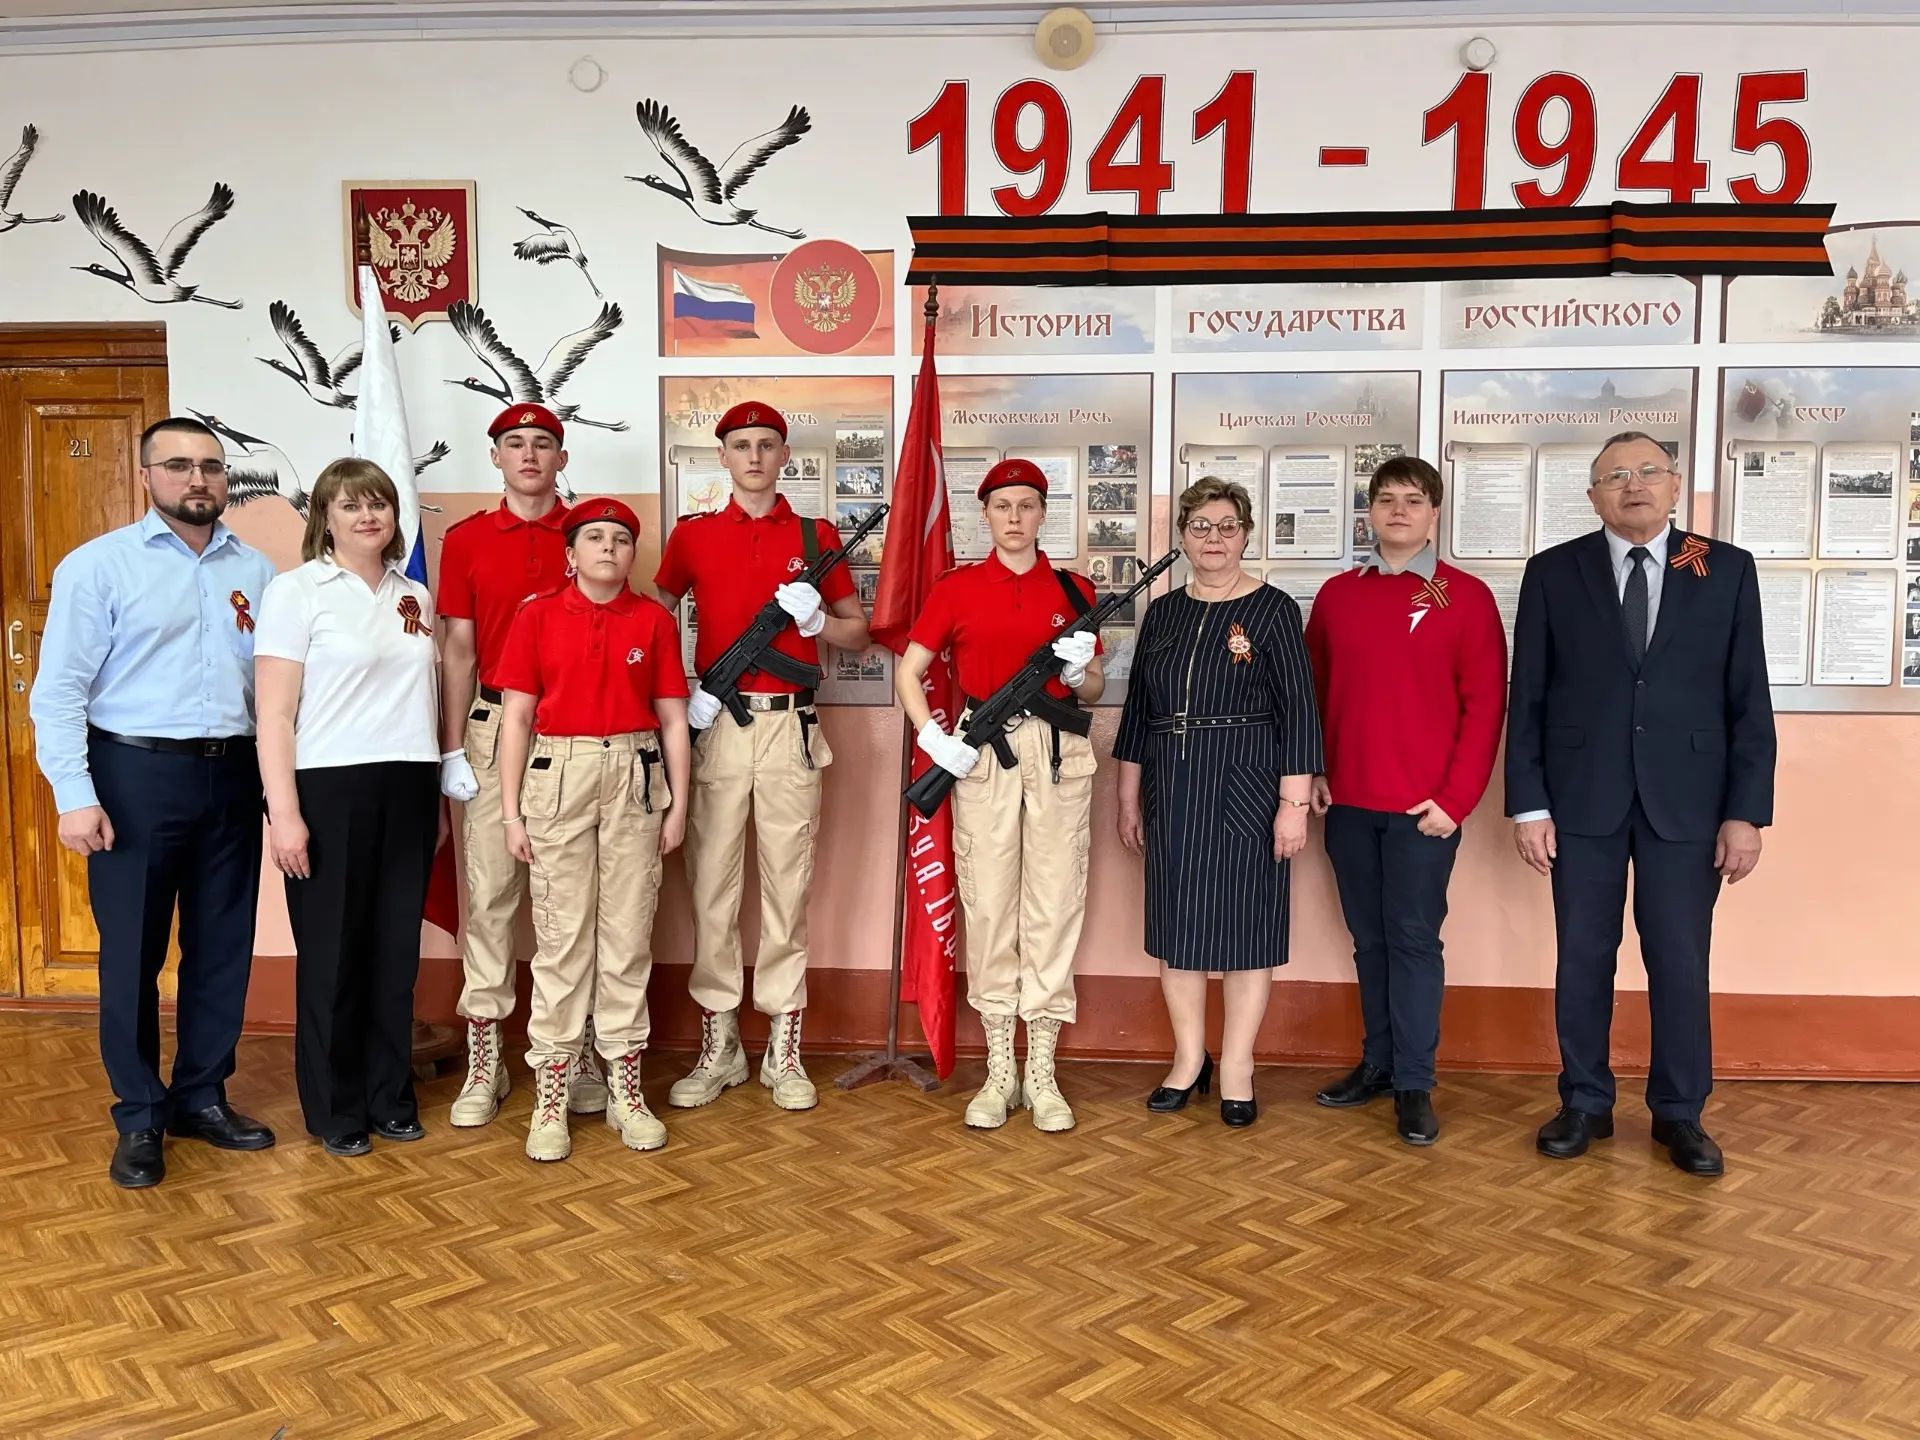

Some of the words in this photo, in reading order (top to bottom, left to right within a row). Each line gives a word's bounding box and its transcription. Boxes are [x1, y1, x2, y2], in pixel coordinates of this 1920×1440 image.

[907, 69, 1257, 217] 1941
[1421, 68, 1812, 212] 1945
[952, 409, 1060, 425] Московская
[1069, 408, 1112, 425] Русь
[1219, 411, 1297, 431] Царская
[1305, 410, 1372, 427] Россия
[1453, 409, 1600, 426] Императорская
[1608, 407, 1679, 424] Россия
[1794, 406, 1847, 423] СССР
[70, 438, 91, 457] 21
